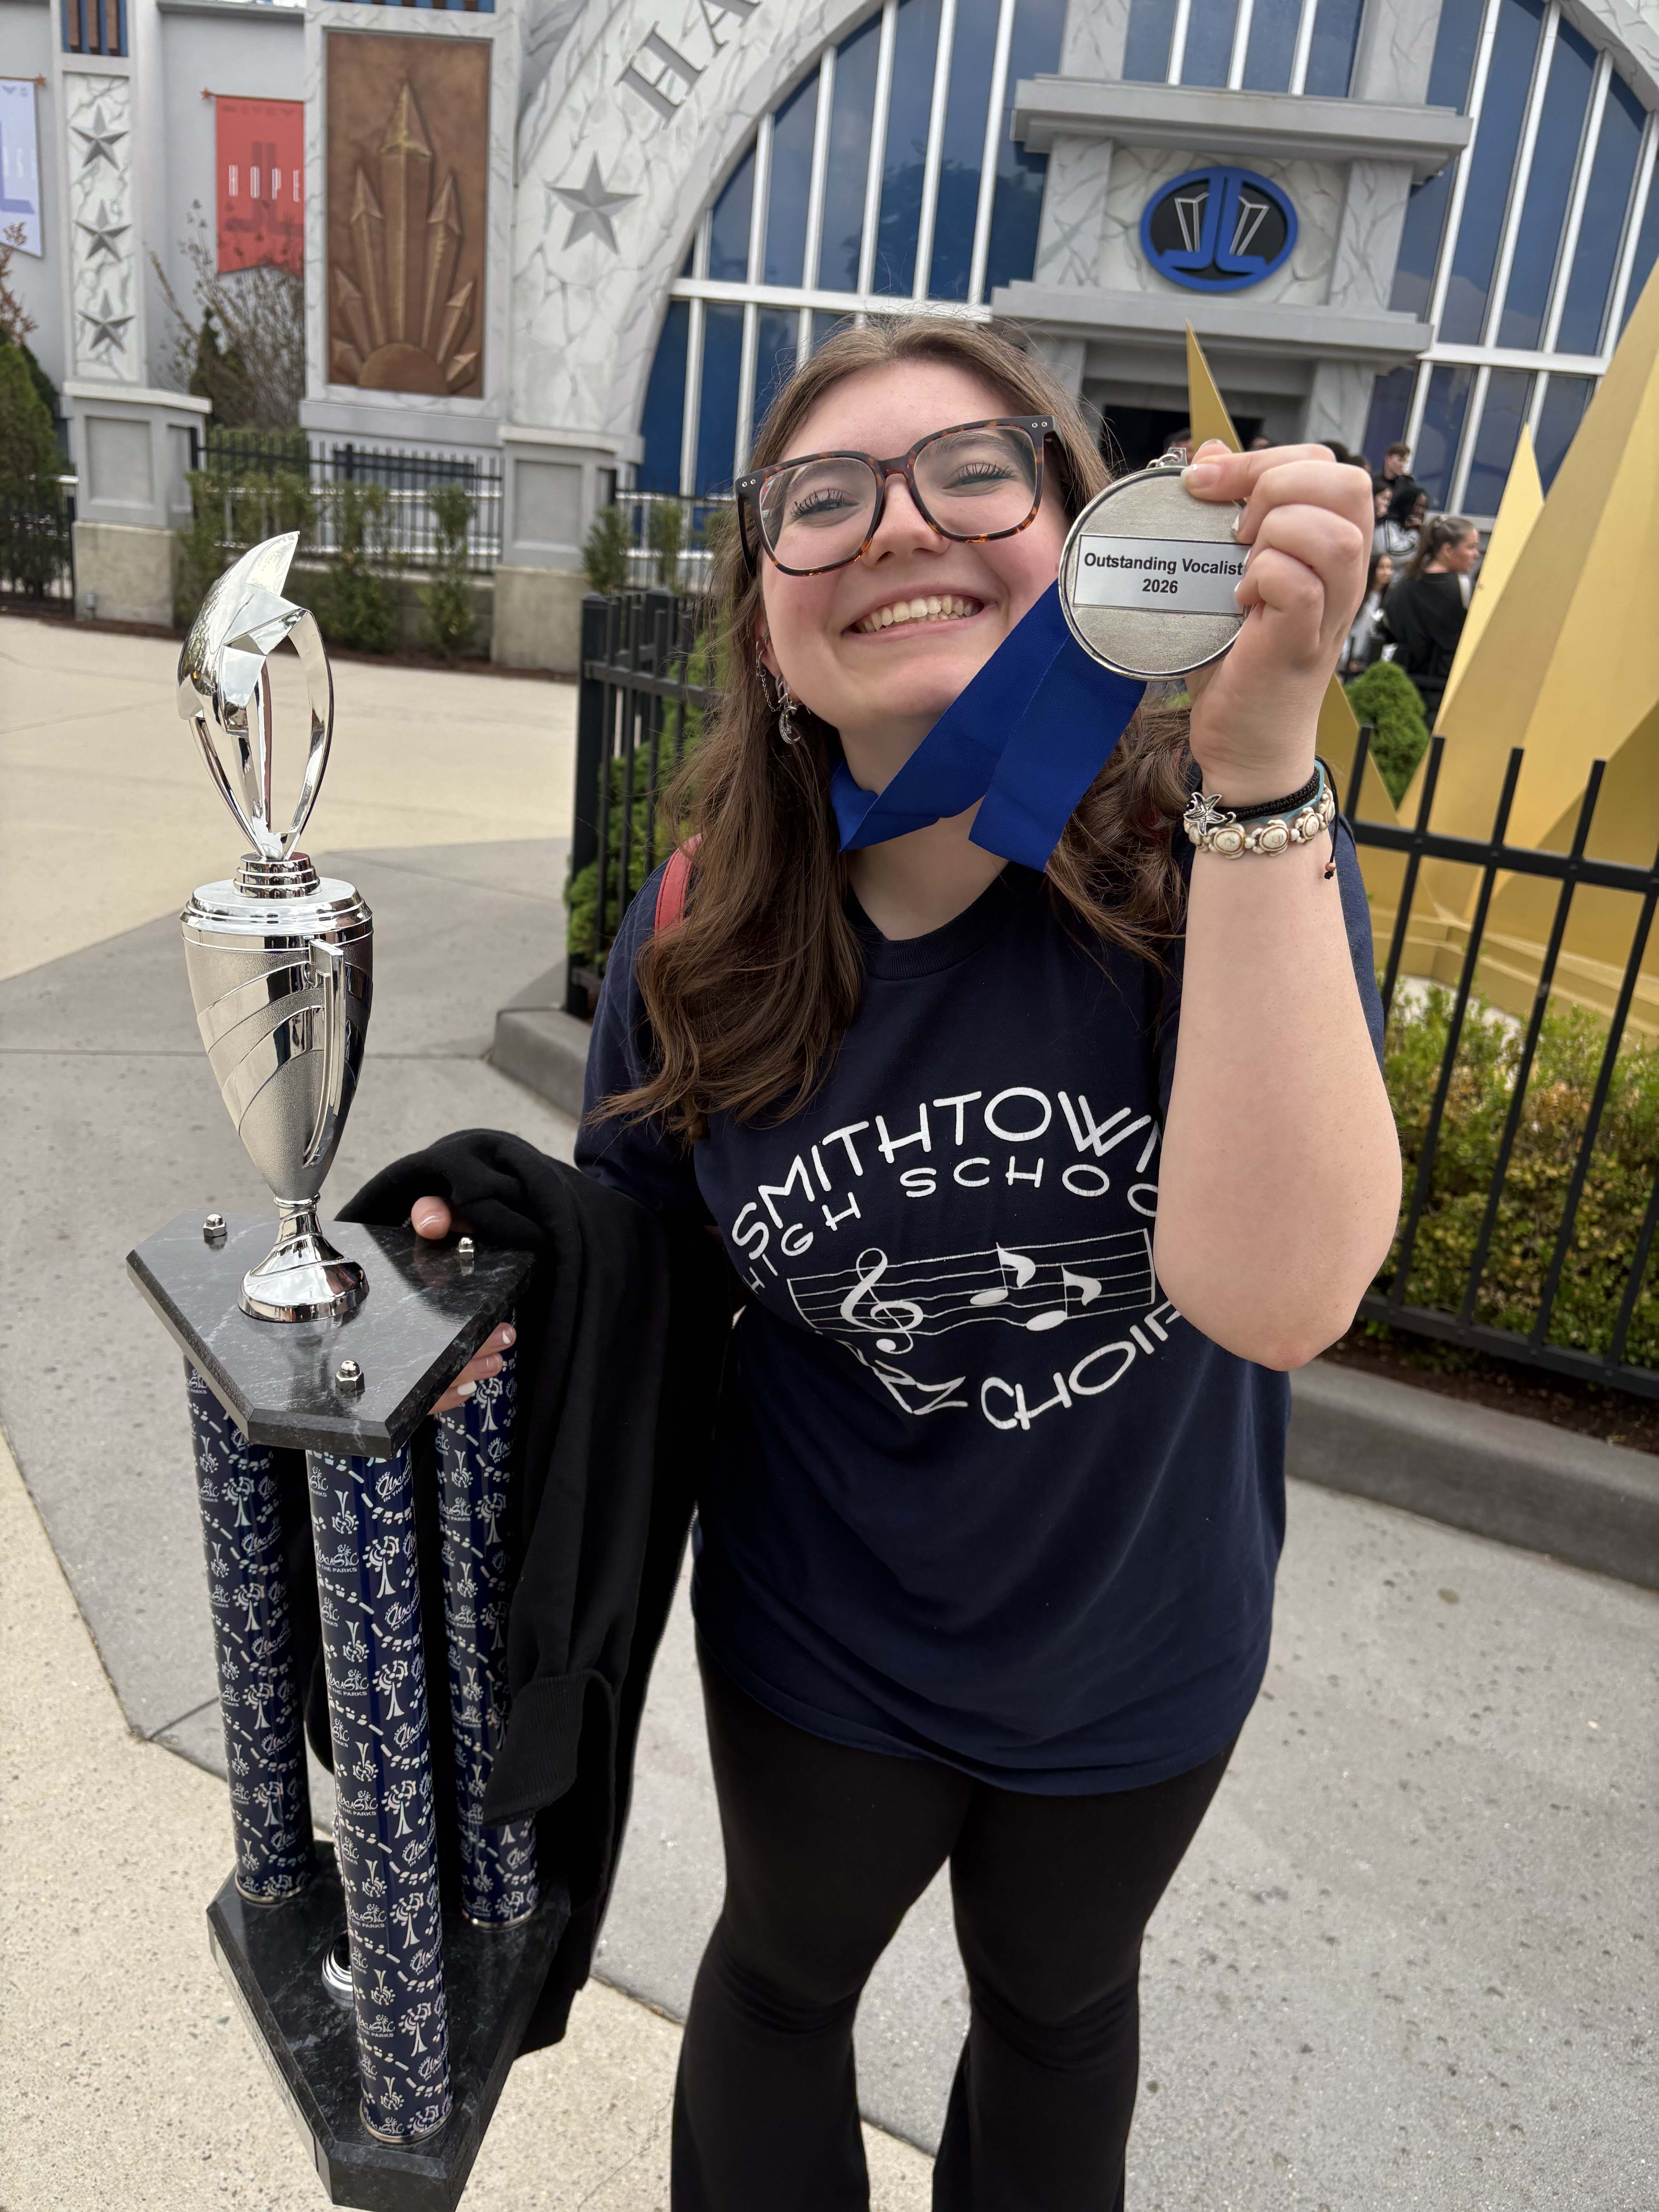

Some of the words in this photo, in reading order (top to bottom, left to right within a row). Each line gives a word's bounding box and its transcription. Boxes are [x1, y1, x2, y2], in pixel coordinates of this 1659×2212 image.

[1084, 553, 1177, 575] Outstanding
[1182, 558, 1243, 575] Vocalist
[1142, 578, 1178, 594] 2026
[742, 1192, 861, 1295] HIGH
